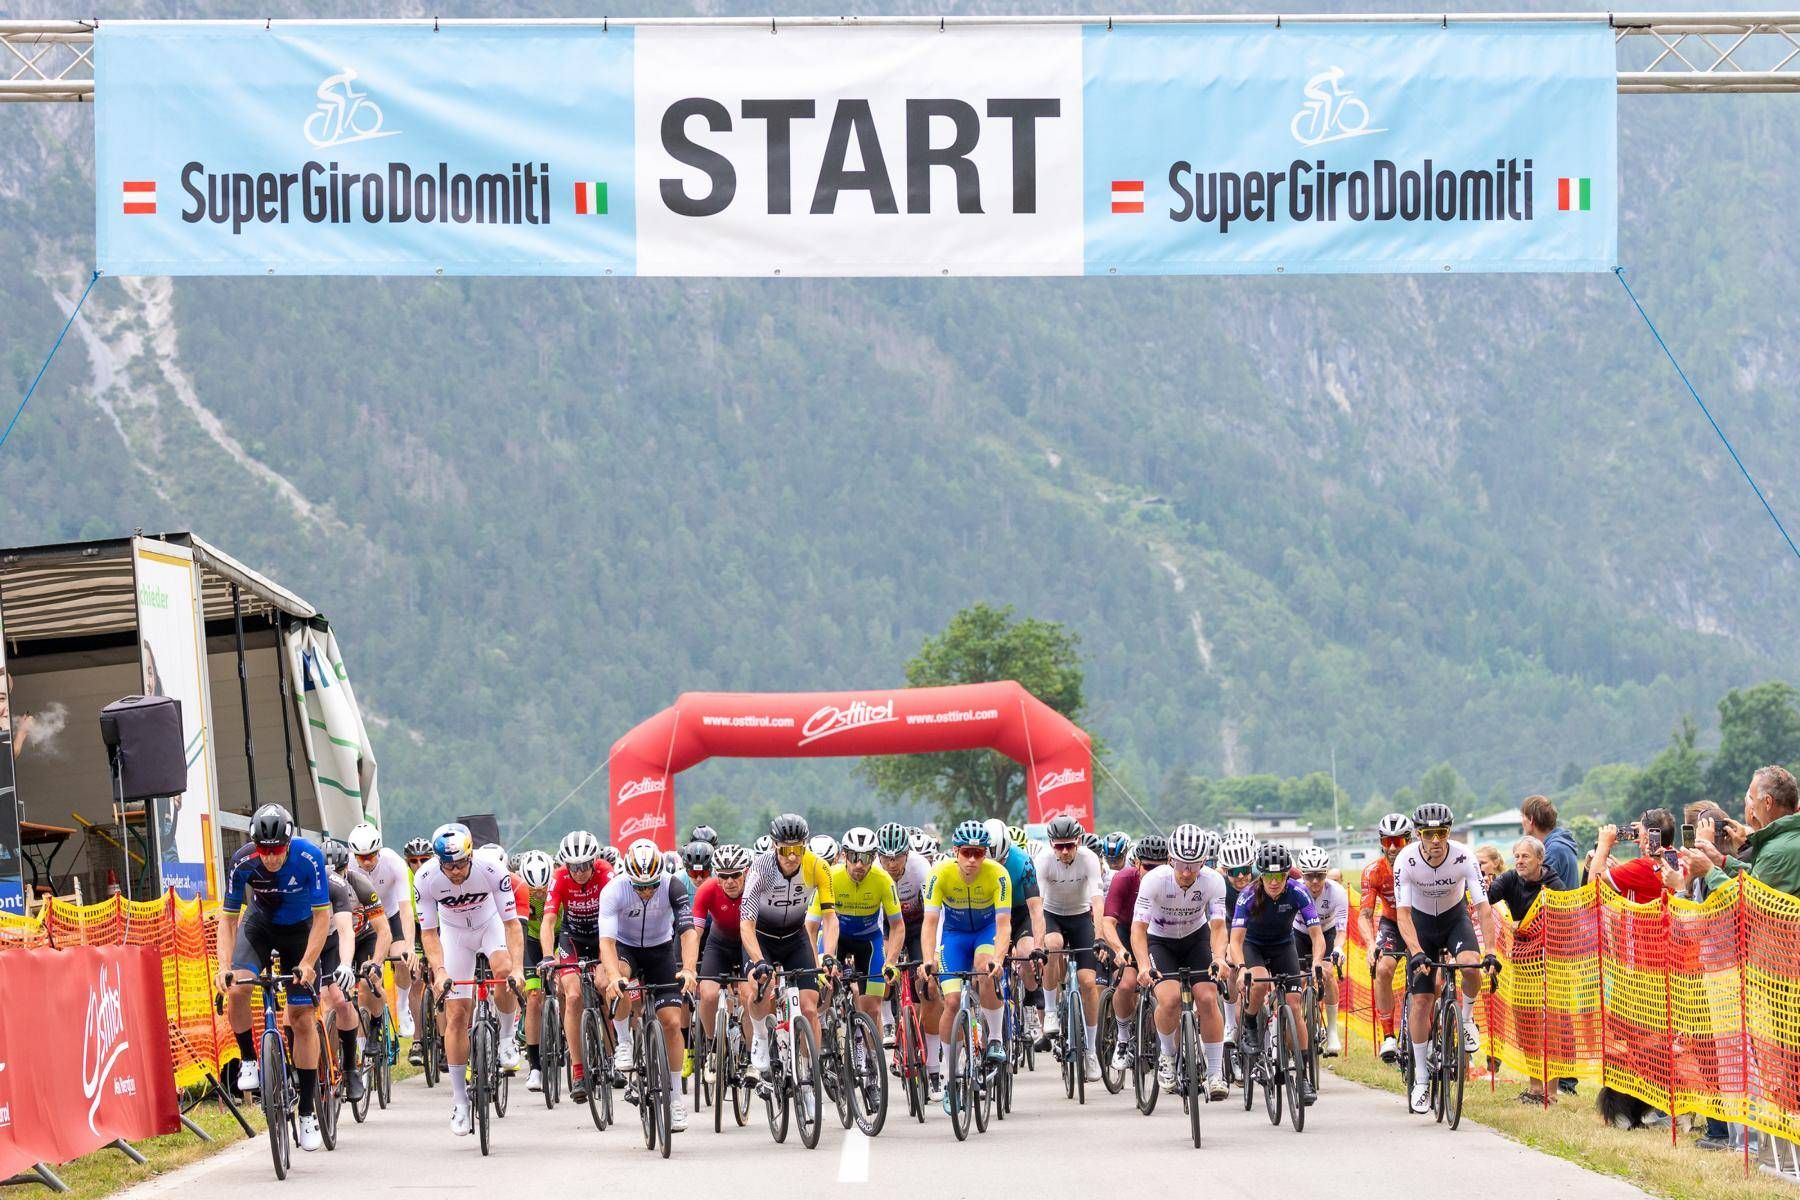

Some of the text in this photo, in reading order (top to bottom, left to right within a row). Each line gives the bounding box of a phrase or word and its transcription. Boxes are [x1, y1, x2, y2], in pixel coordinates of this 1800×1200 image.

[659, 97, 1061, 217] START
[181, 161, 550, 235] SuperGiroDolomiti
[1168, 158, 1533, 233] SuperGiroDolomiti
[703, 716, 794, 728] www.osttirol.com
[800, 699, 893, 740] Osttirol
[906, 709, 998, 724] www.osttirol.com
[618, 777, 666, 803] Osttirol
[1038, 768, 1086, 795] Osttirol
[619, 813, 667, 839] Osttirol
